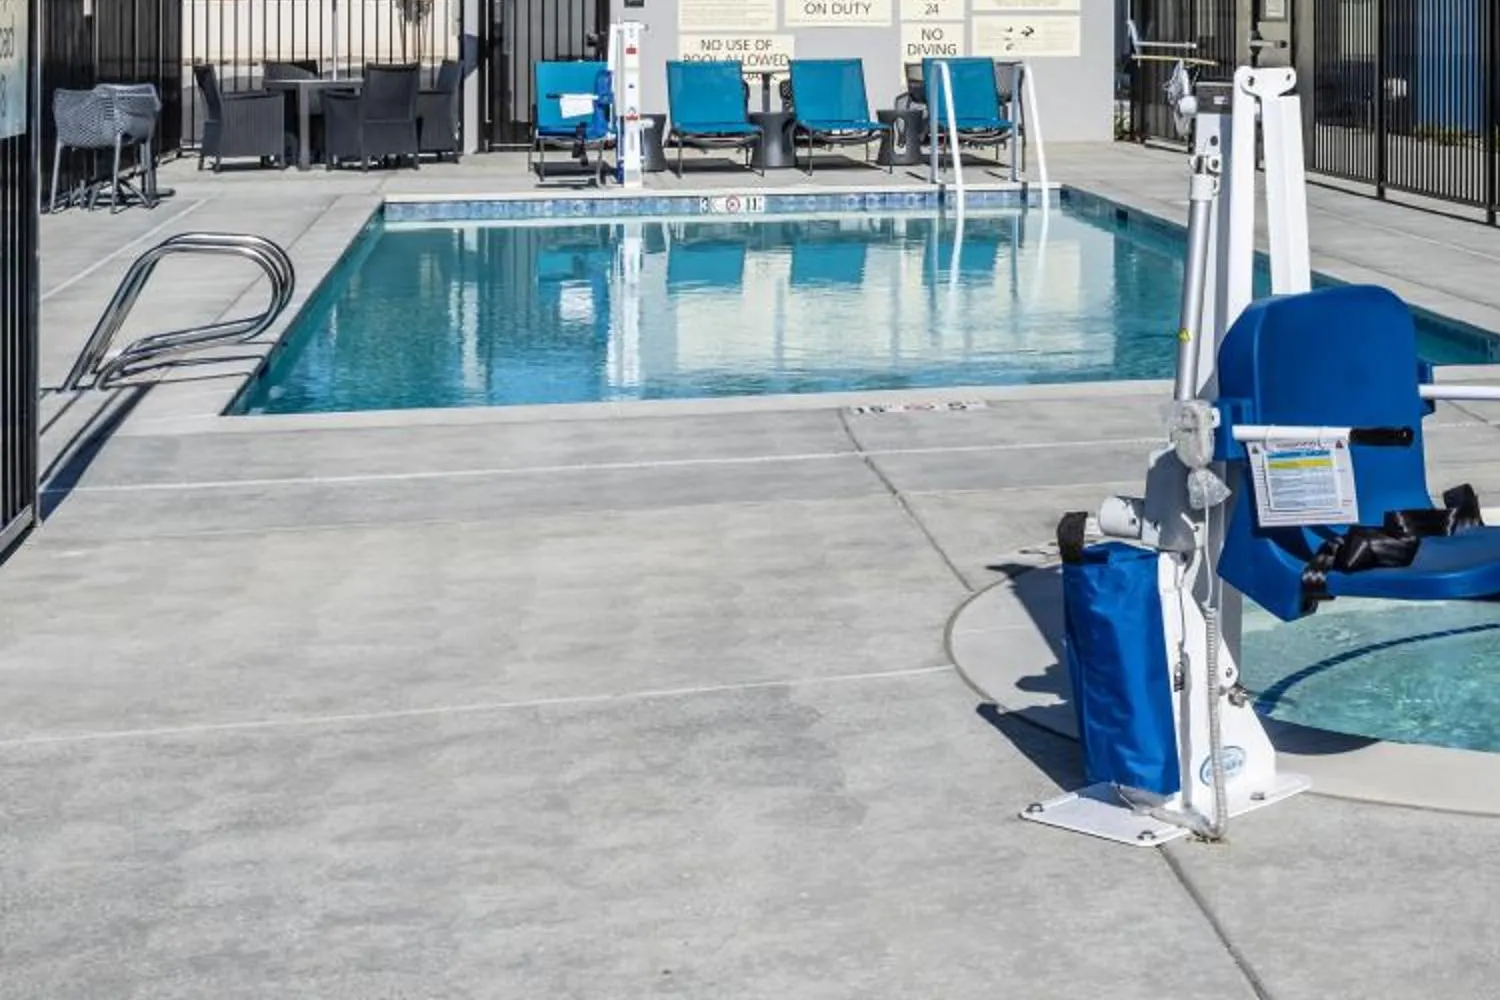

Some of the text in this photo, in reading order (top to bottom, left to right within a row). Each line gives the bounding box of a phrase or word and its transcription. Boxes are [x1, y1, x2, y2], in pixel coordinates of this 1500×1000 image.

[804, 2, 872, 15] ON DUTY
[924, 3, 939, 15] 24
[921, 28, 944, 41] NO
[701, 39, 773, 51] NO USE OF
[907, 43, 957, 57] DIVING
